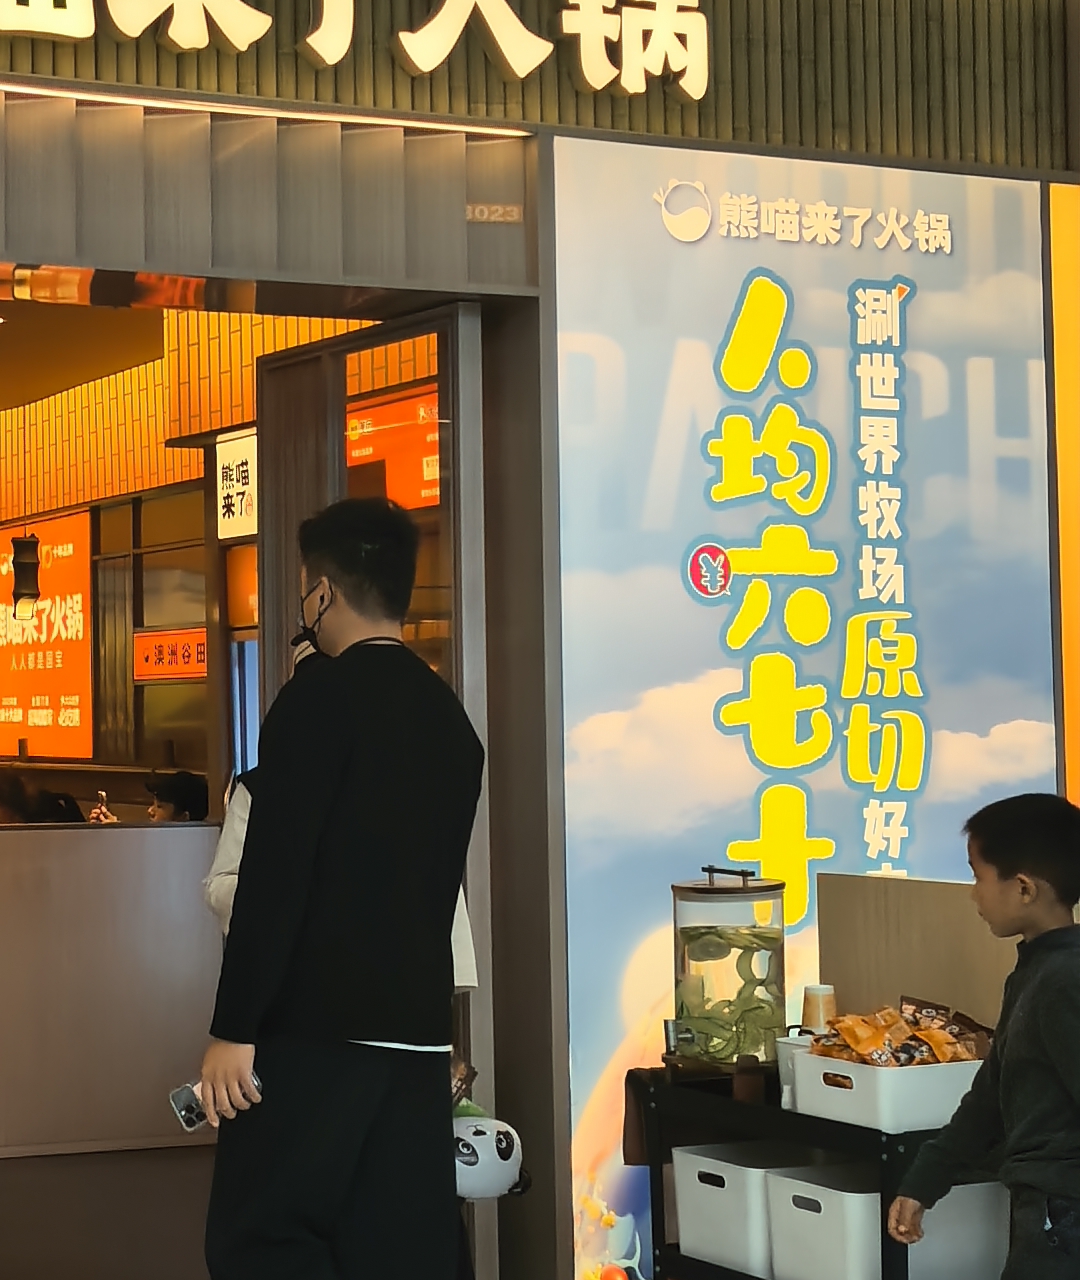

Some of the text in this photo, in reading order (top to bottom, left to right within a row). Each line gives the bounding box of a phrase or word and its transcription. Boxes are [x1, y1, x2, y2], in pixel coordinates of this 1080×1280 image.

[718, 191, 952, 255] 熊喵来了火锅
[221, 458, 250, 490] 熊喵
[221, 490, 246, 520] 来了
[707, 274, 840, 927] 人均六七十
[839, 287, 926, 880] 涮世界牧场原切好
